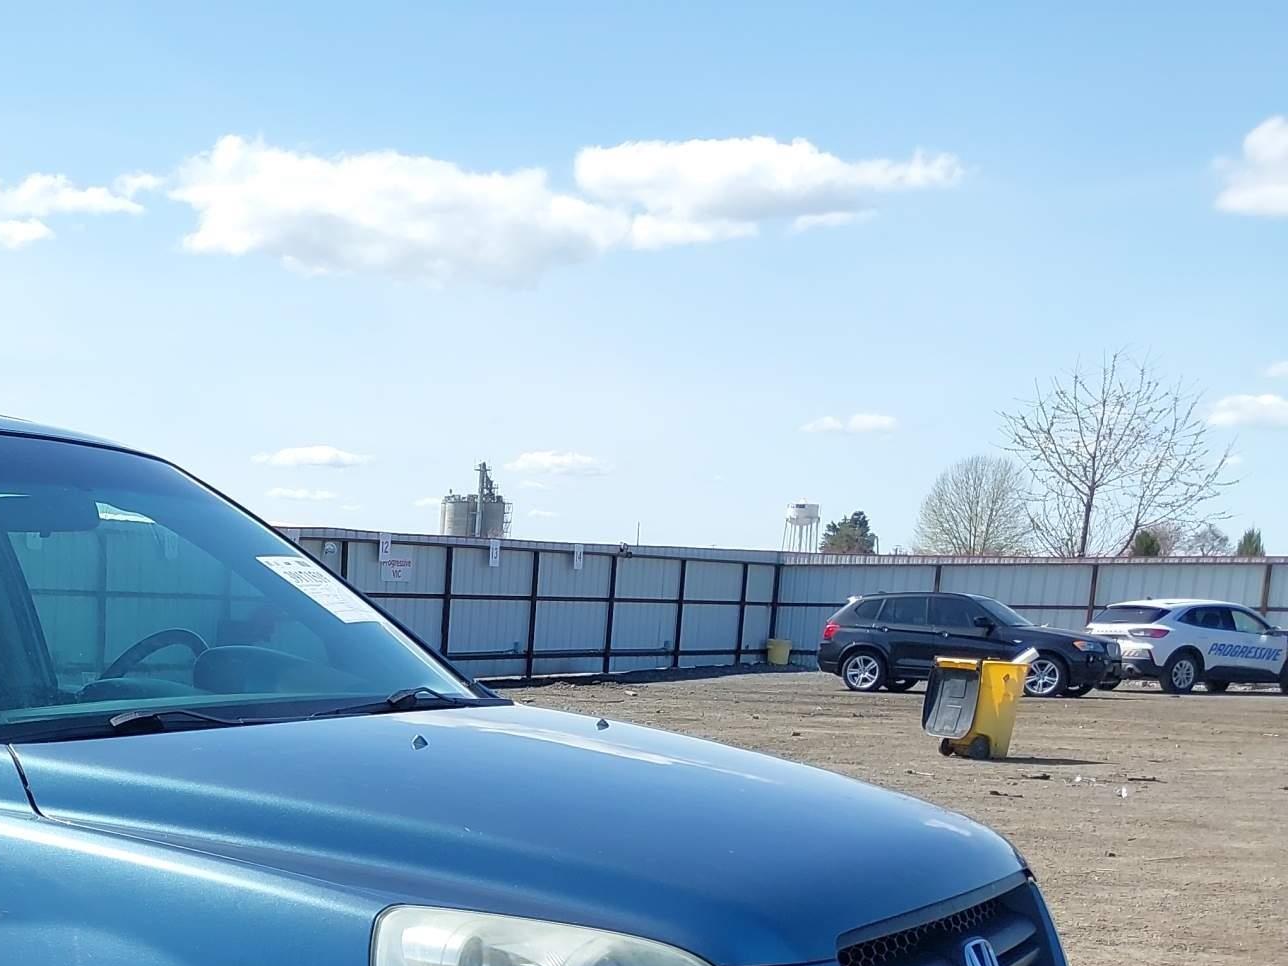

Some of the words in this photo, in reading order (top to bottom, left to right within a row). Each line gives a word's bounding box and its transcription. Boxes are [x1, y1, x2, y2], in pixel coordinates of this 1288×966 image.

[381, 540, 390, 554] 12
[491, 547, 498, 560] 13
[1208, 642, 1283, 661] PROGRESSIVE
